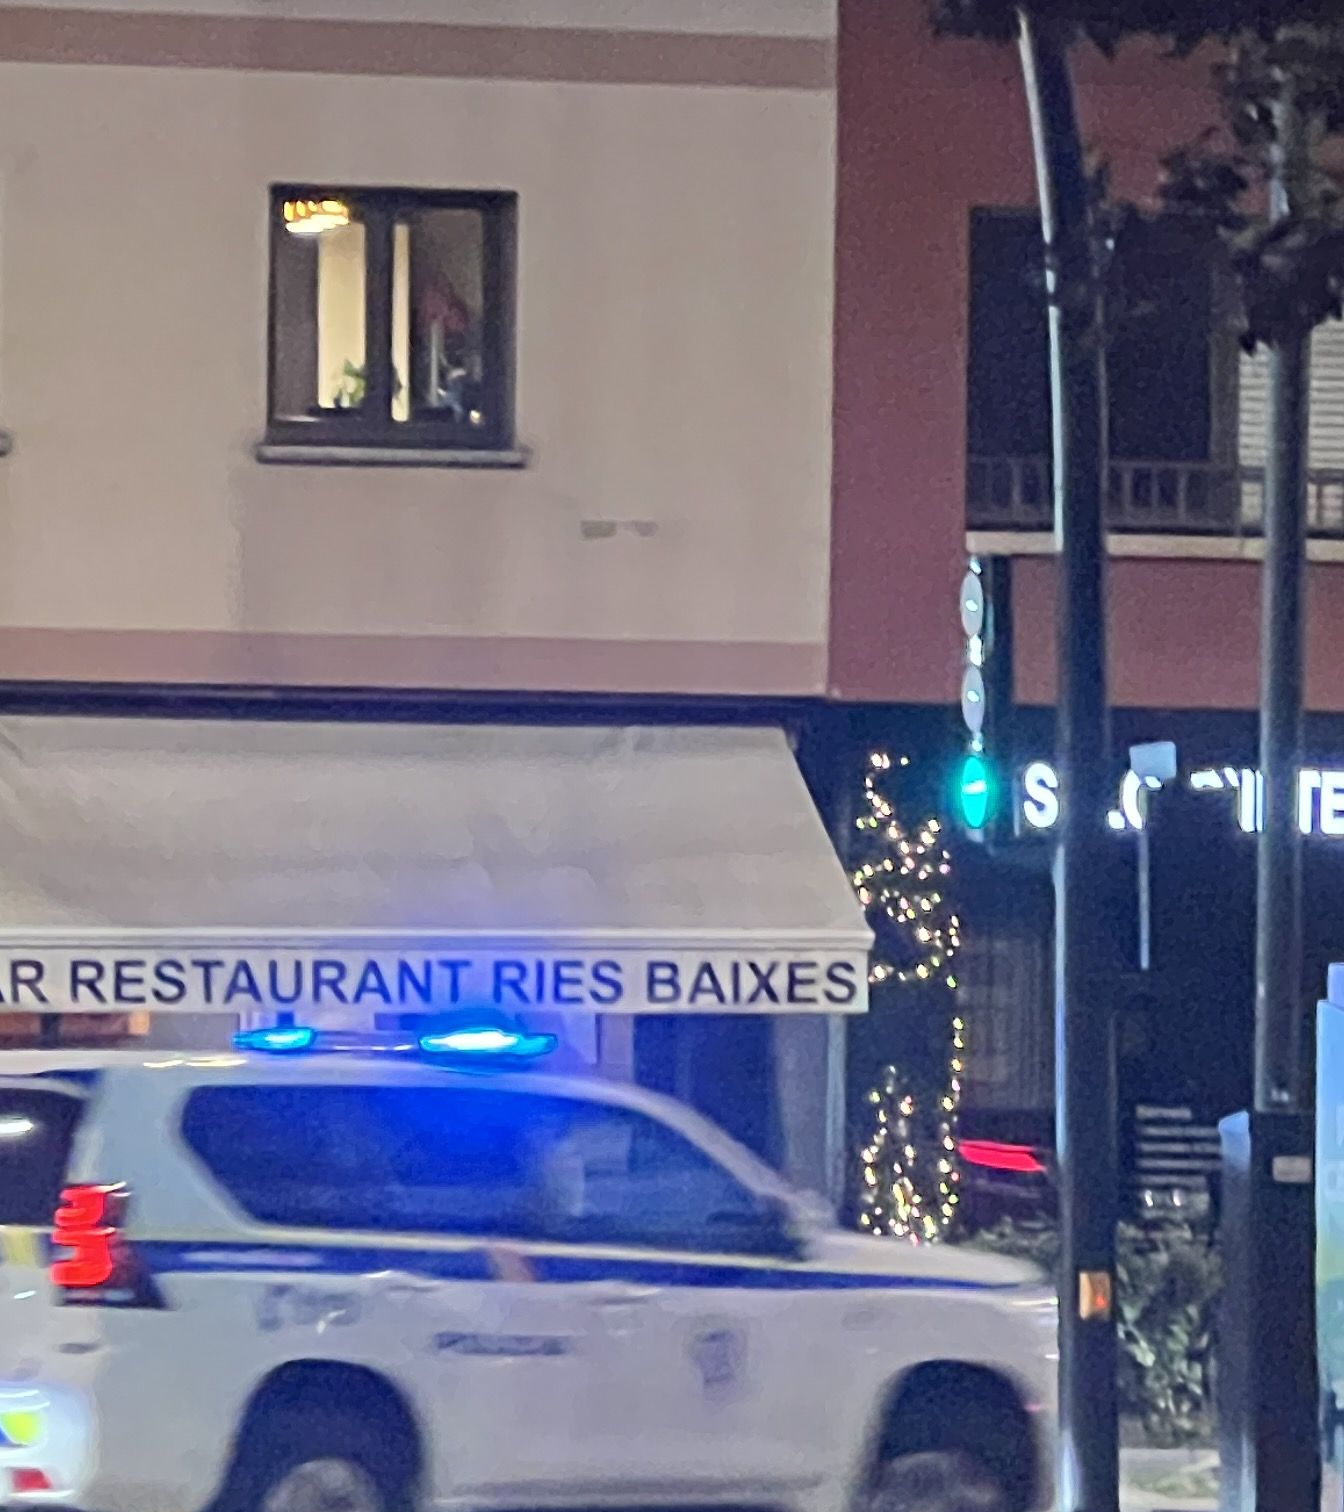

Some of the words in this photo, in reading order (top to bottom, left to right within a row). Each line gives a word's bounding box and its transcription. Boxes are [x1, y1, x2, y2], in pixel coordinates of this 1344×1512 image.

[70, 958, 471, 1005] RESTAURANT
[493, 959, 624, 1005] RIES
[647, 960, 857, 1005] BAIXES
